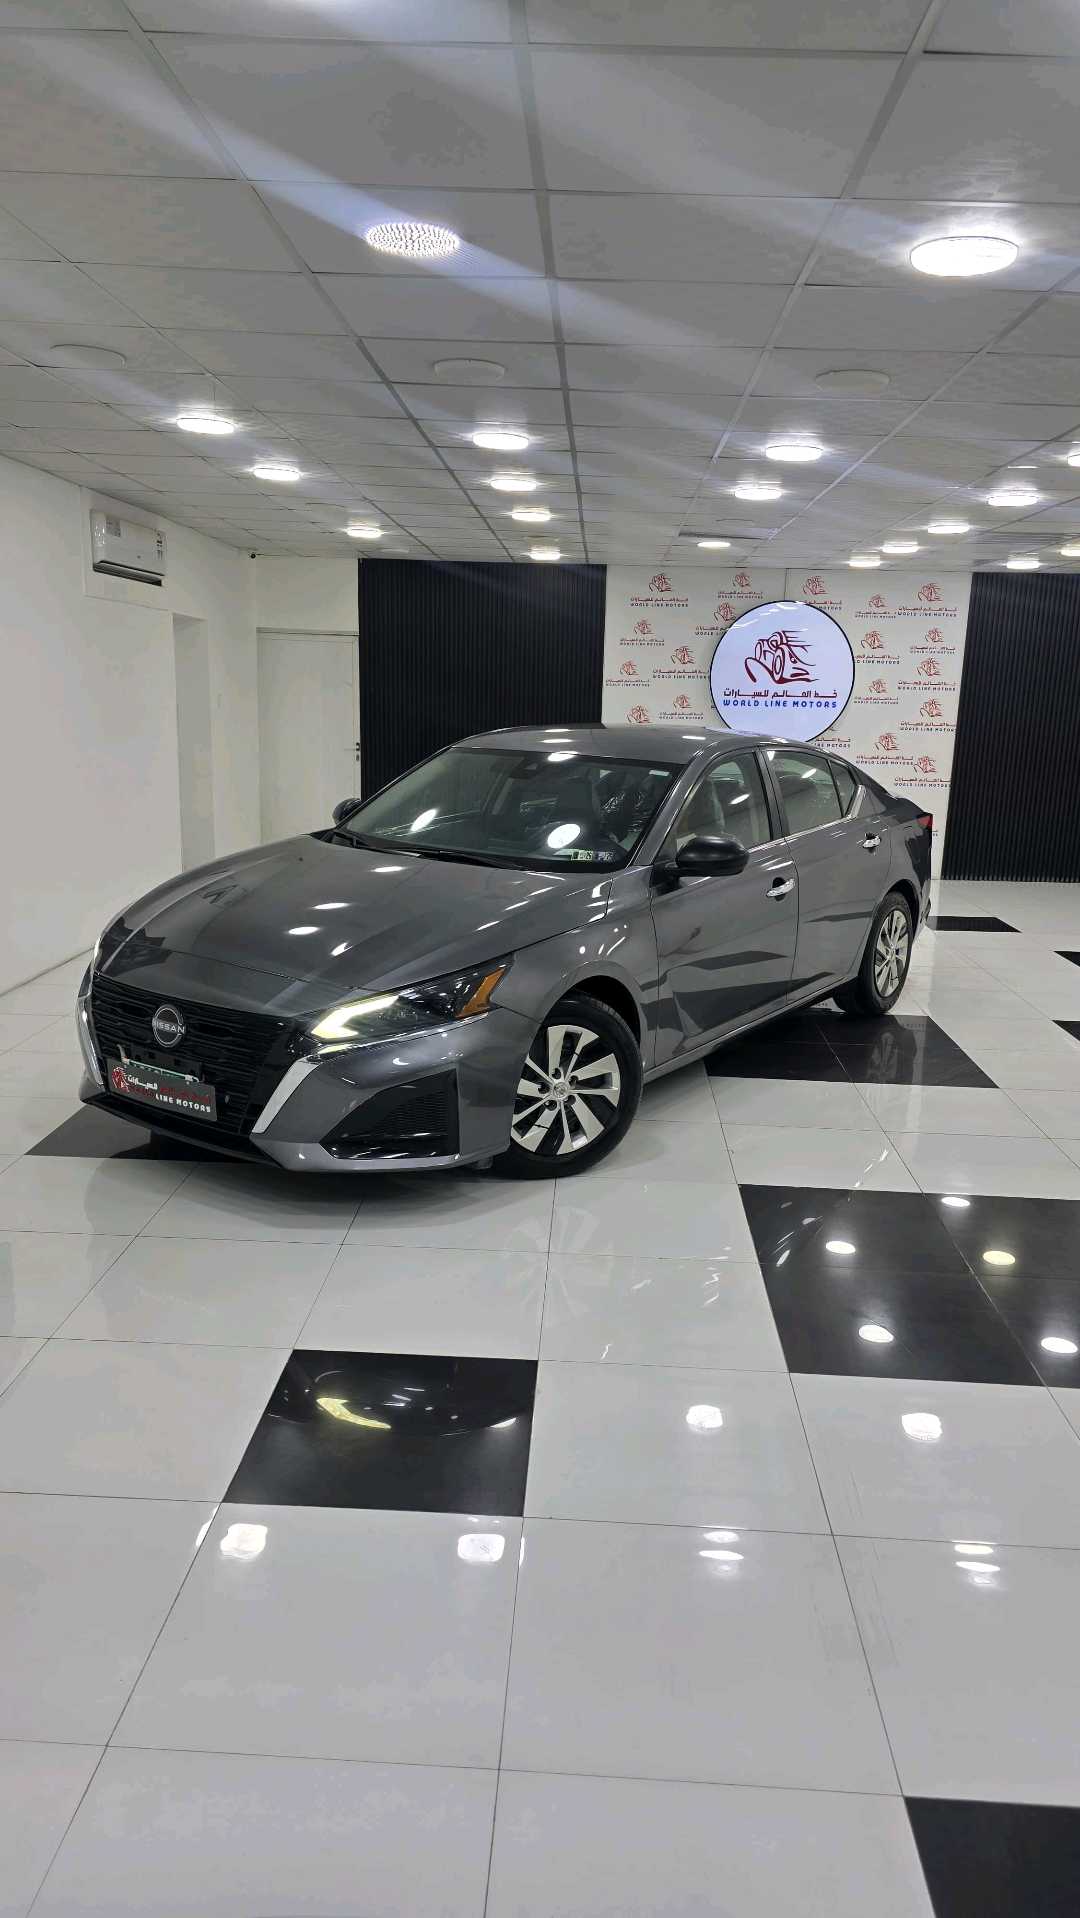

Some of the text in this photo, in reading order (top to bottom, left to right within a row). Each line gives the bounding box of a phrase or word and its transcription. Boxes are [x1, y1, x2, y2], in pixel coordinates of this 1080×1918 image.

[724, 688, 837, 699] خط العالم للسيارات
[152, 1018, 185, 1034] NISSAN
[156, 1094, 173, 1103] LINE
[176, 1099, 211, 1112] MOTORS
